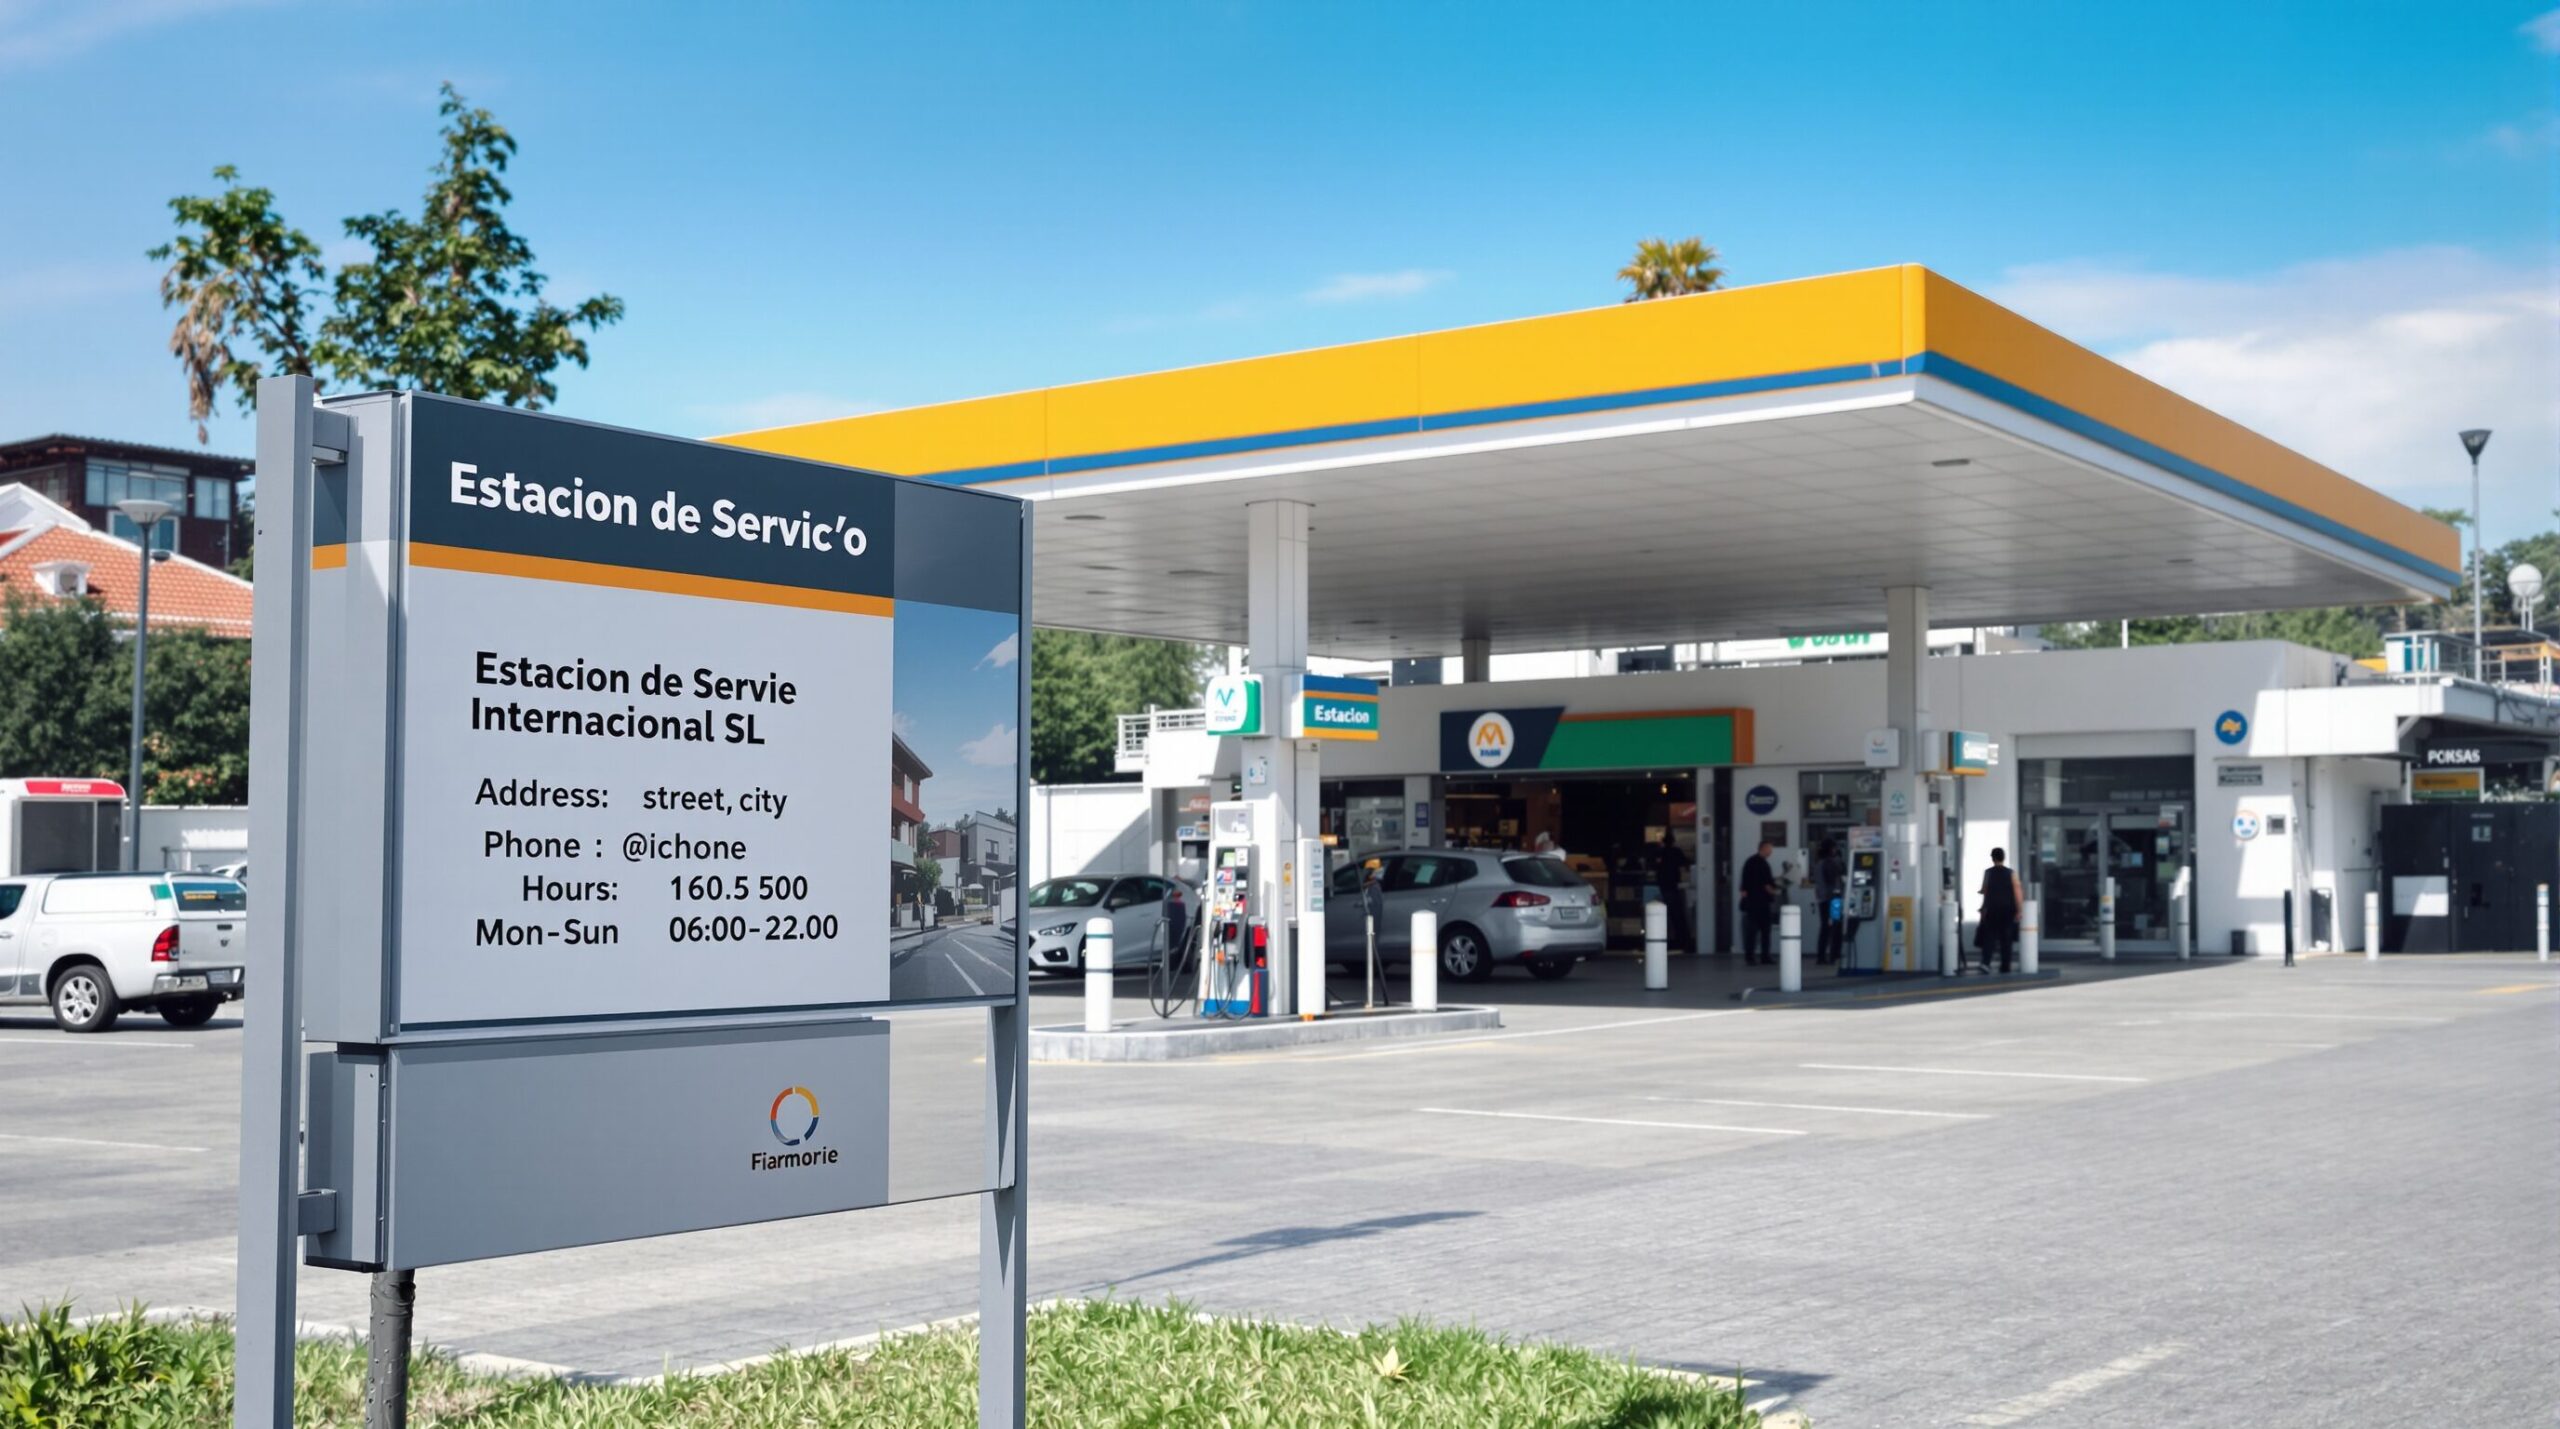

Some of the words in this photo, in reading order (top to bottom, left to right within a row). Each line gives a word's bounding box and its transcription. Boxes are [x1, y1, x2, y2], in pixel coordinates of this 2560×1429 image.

[450, 460, 638, 527] Estacion
[650, 490, 701, 534] de
[476, 650, 630, 694] Estacion
[640, 663, 683, 698] de
[693, 667, 797, 705] Servie
[472, 697, 715, 743] Internacional
[724, 712, 766, 745] SL
[1314, 704, 1370, 723] Estacion
[474, 777, 608, 809] Address:
[643, 786, 733, 816] street,
[739, 786, 788, 820] city
[484, 829, 581, 858] Phone
[622, 832, 747, 863] @ichone
[523, 874, 618, 902] Hours:
[670, 875, 750, 901] 160.5
[759, 875, 808, 901] 500
[476, 918, 619, 947] Mon-Sun
[669, 914, 839, 943] 06:00-22.00
[751, 1146, 839, 1171] Fiarmorie
